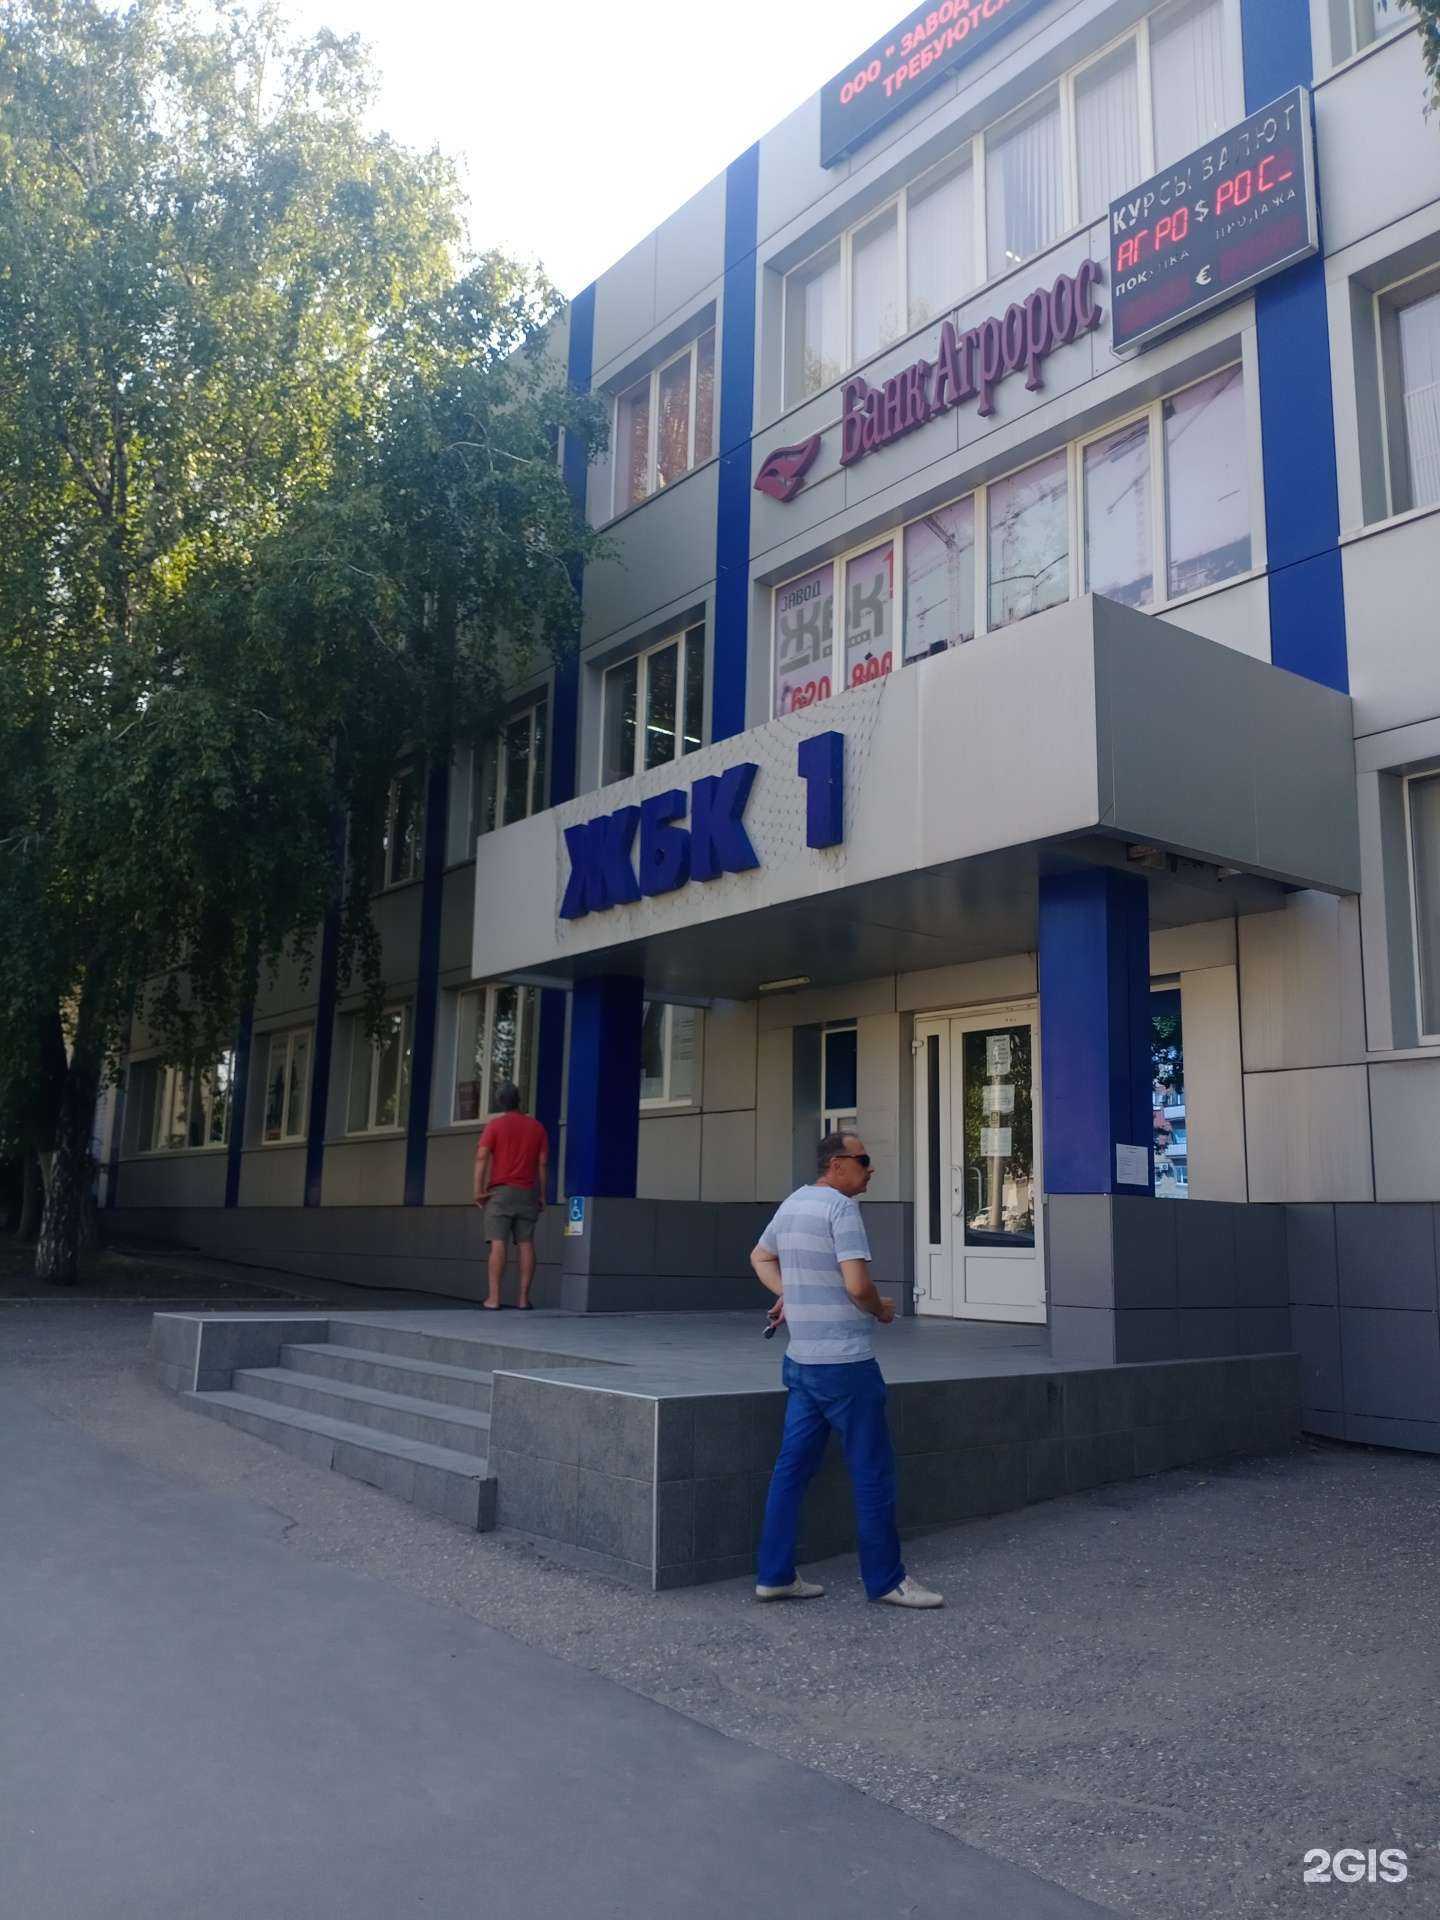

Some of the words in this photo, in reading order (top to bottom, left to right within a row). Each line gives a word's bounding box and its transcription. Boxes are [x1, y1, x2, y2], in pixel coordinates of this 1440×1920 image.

[840, 59, 882, 104] ООО
[781, 580, 821, 612] ЗАВОД
[559, 762, 760, 920] ЖБК
[798, 730, 844, 850] 1
